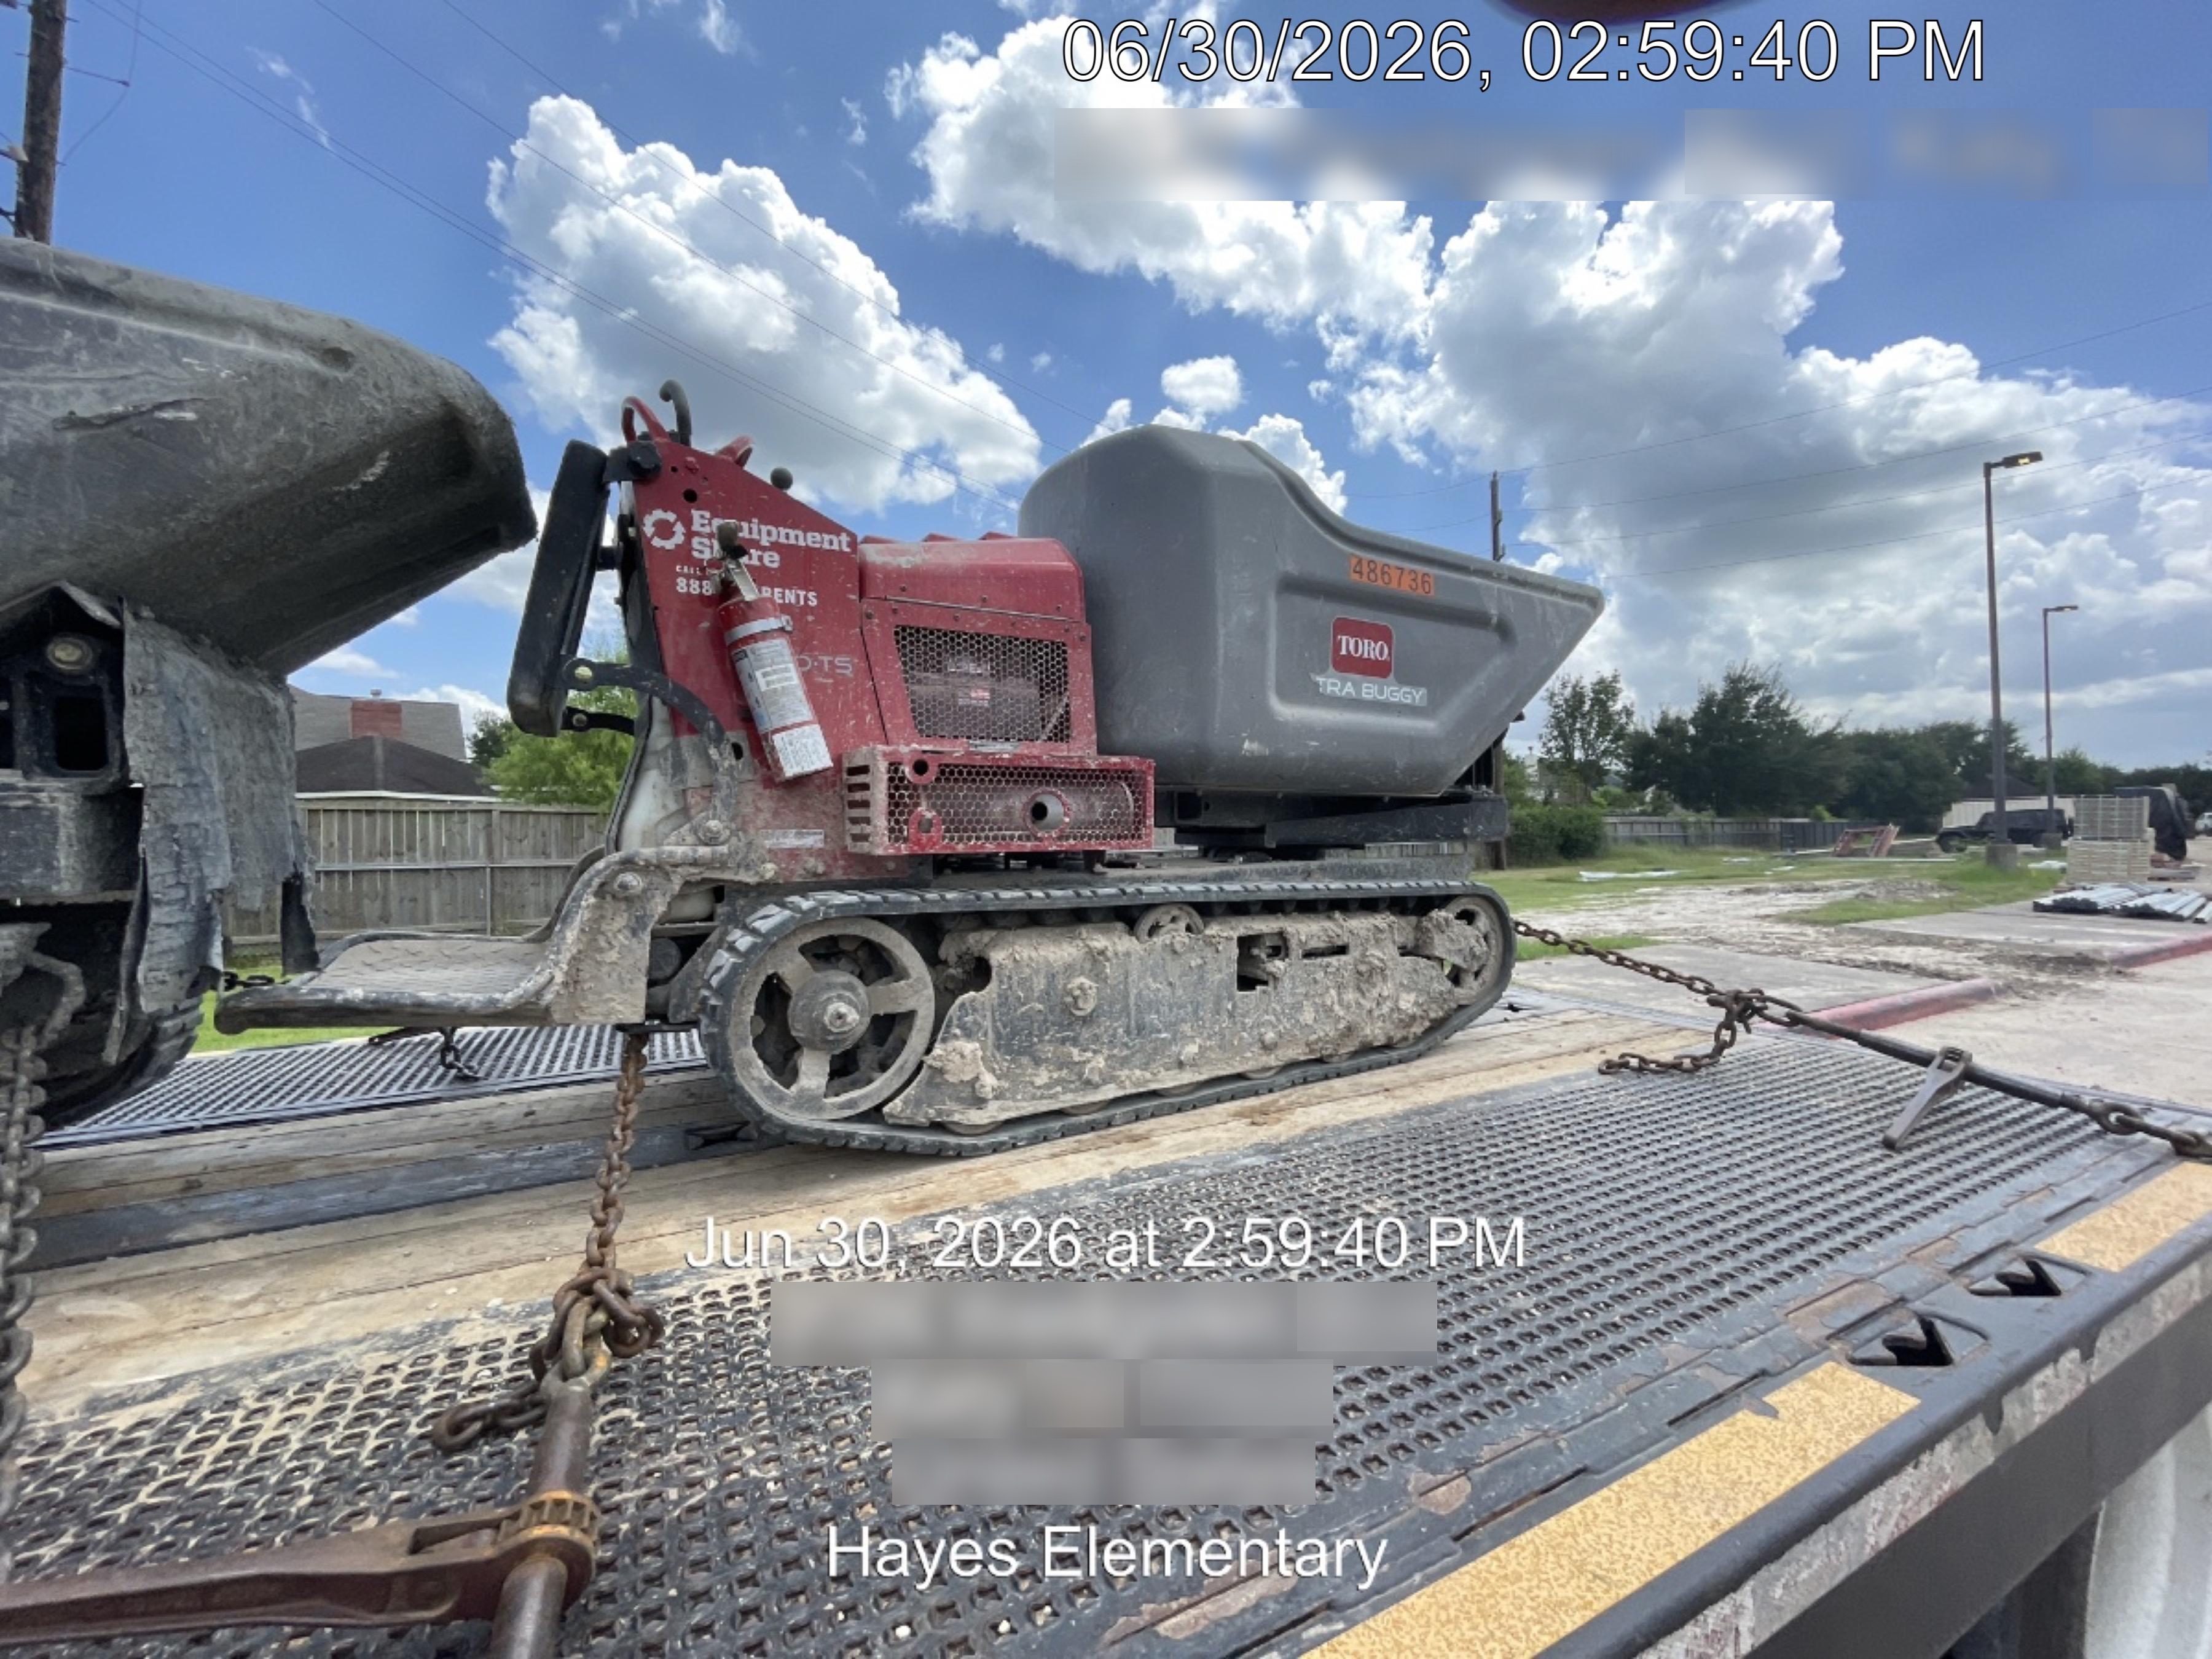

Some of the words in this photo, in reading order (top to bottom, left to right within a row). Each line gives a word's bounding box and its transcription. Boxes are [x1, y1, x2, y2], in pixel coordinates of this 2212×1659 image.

[1352, 557, 1432, 594] 486736
[1337, 635, 1389, 661] TORO
[1361, 683, 1424, 705] BUGGY
